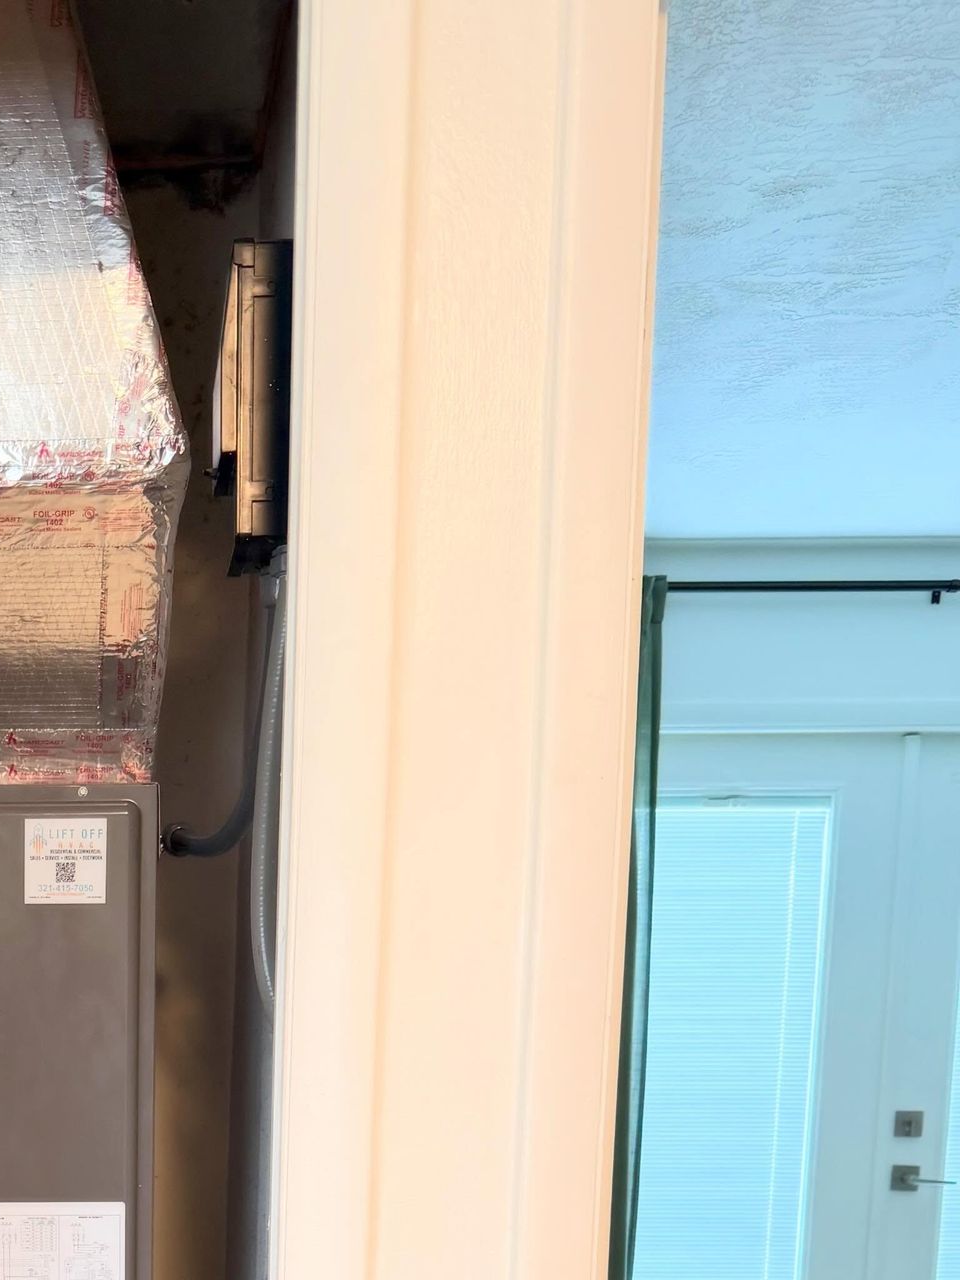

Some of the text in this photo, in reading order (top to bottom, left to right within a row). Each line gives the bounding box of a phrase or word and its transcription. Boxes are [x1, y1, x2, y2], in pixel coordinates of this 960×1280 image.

[33, 510, 75, 518] FOIL-GRIP
[49, 829, 104, 839] LIFT OFF
